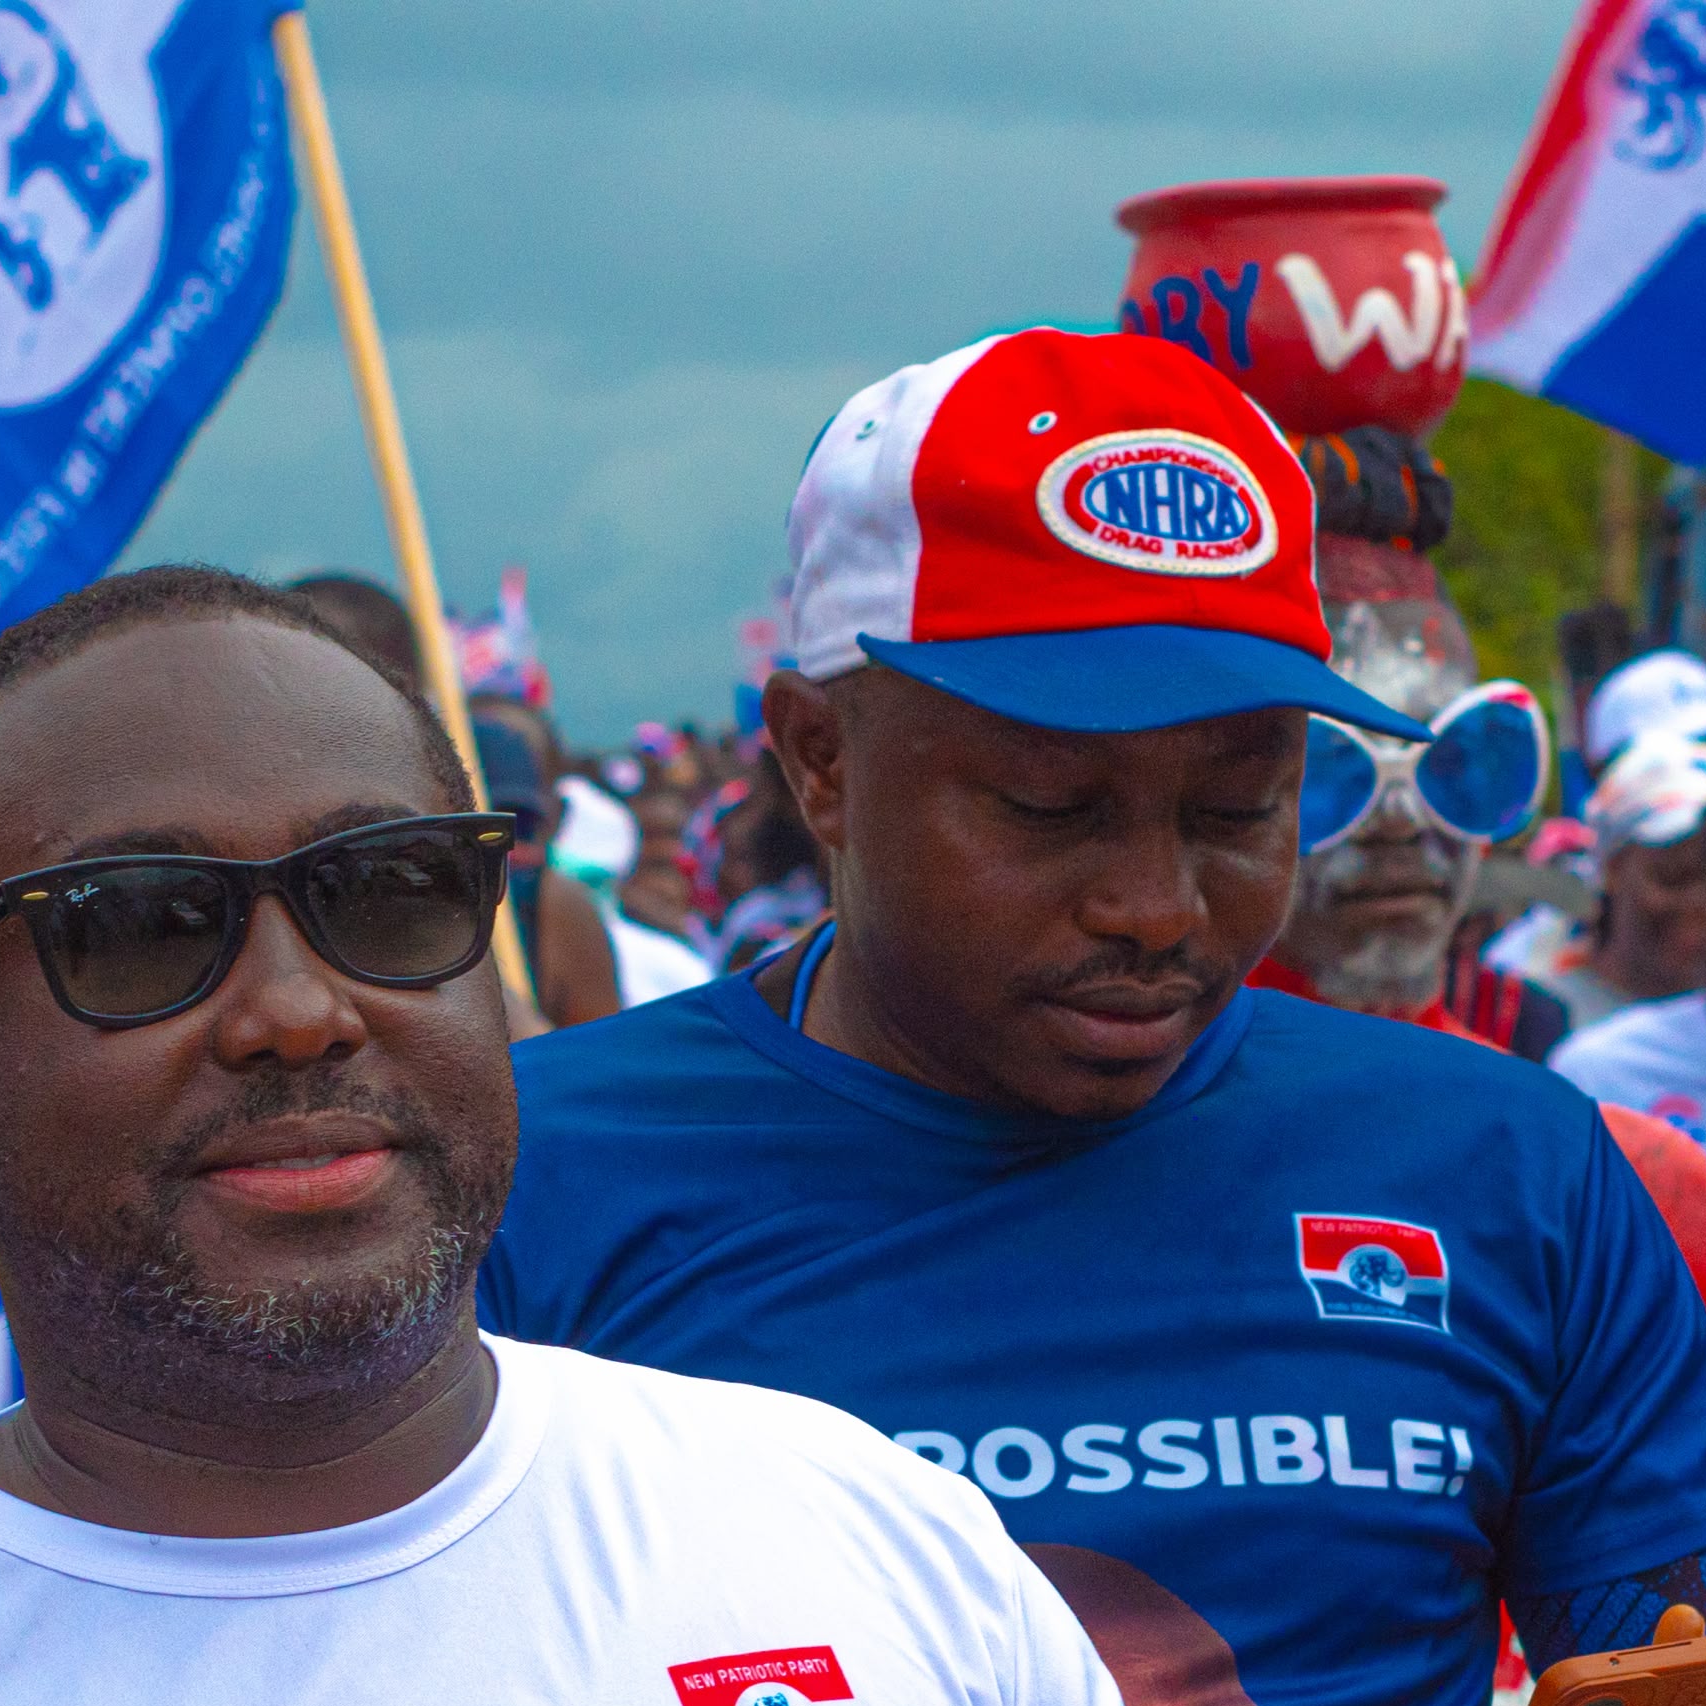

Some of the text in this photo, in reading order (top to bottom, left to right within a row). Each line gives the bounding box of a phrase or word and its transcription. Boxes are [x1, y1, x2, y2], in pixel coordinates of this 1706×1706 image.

[1090, 466, 1246, 540] NHRA
[1098, 526, 1246, 559] DRAG RACING
[683, 1657, 831, 1692] NEW PATRIOTIC PARTY
